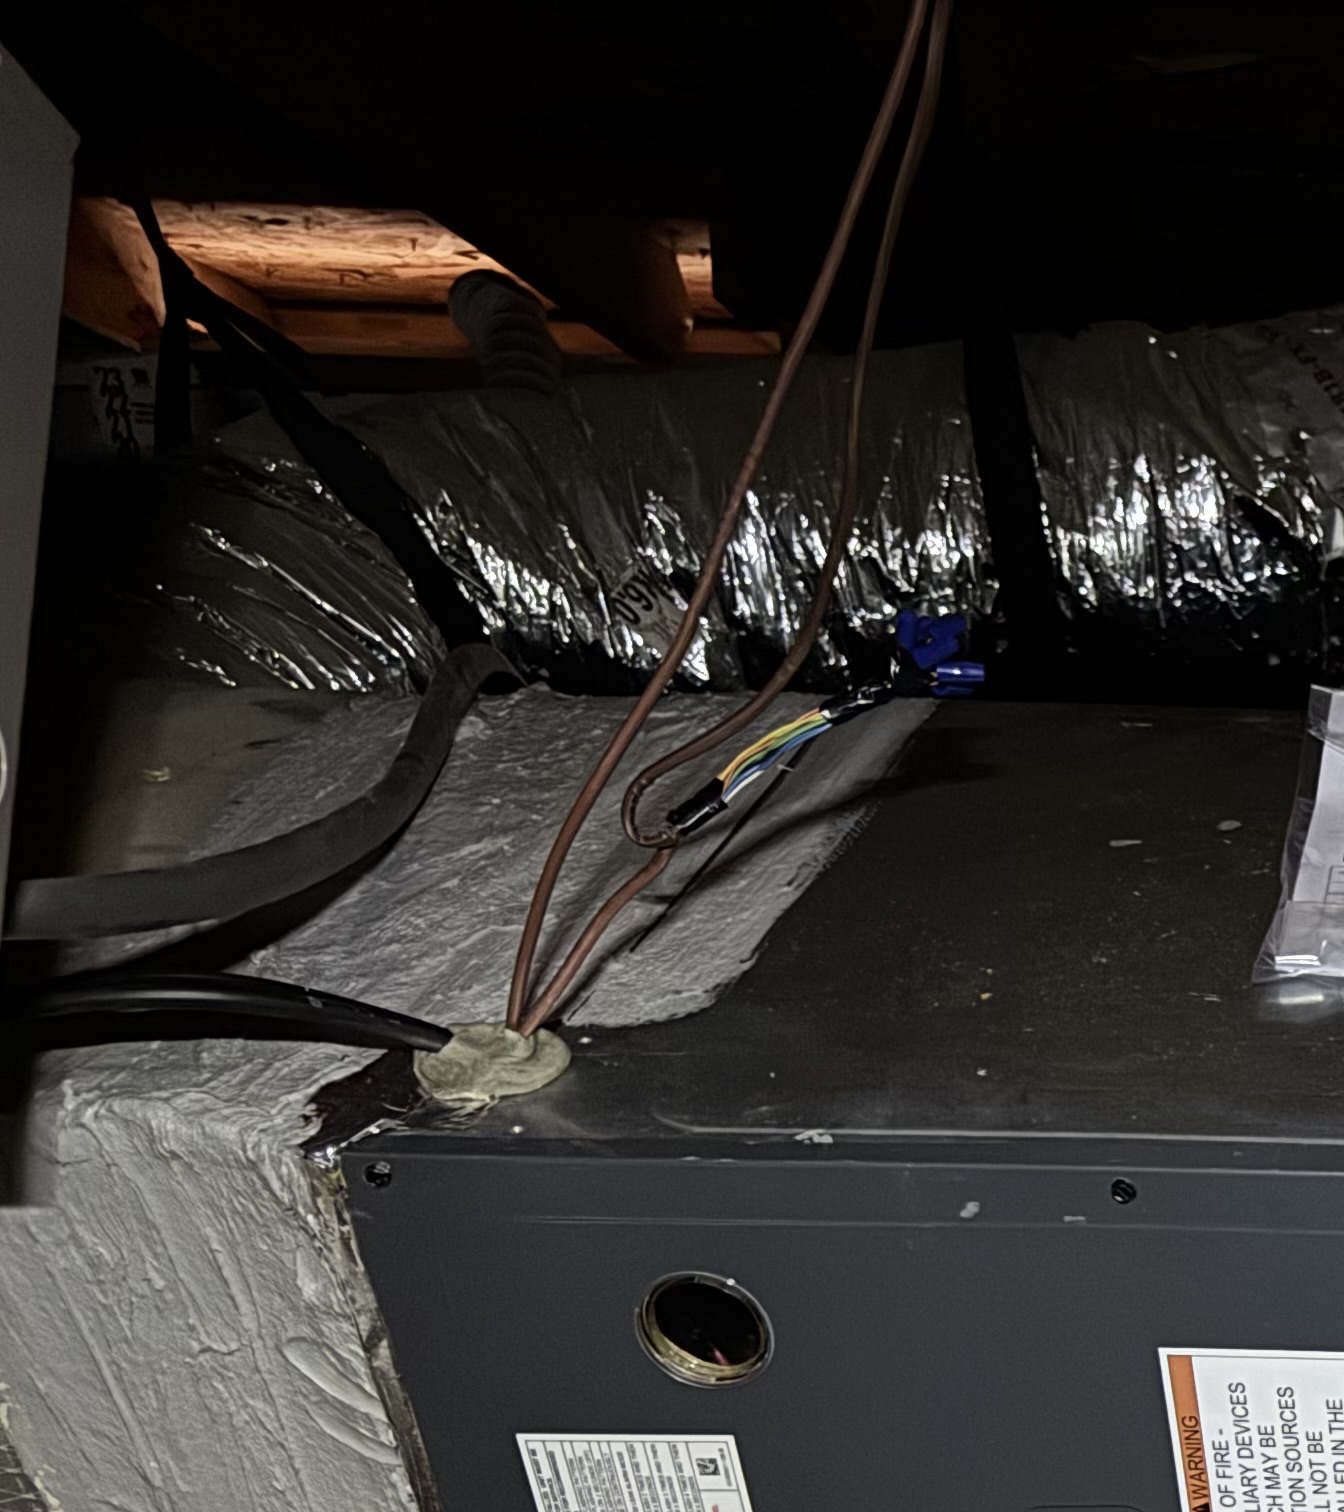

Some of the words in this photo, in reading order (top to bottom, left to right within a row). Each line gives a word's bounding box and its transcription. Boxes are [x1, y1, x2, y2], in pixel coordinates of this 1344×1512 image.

[1227, 1382, 1254, 1458] DEVICES
[1257, 1425, 1276, 1447] BE
[1275, 1386, 1303, 1472] SOURCES
[1179, 1414, 1210, 1500] WARNING
[1211, 1440, 1233, 1478] FIRE
[1305, 1431, 1324, 1453] BE
[1260, 1452, 1281, 1489] MAY
[1307, 1458, 1329, 1494] NOT
[1217, 1484, 1237, 1507] OF
